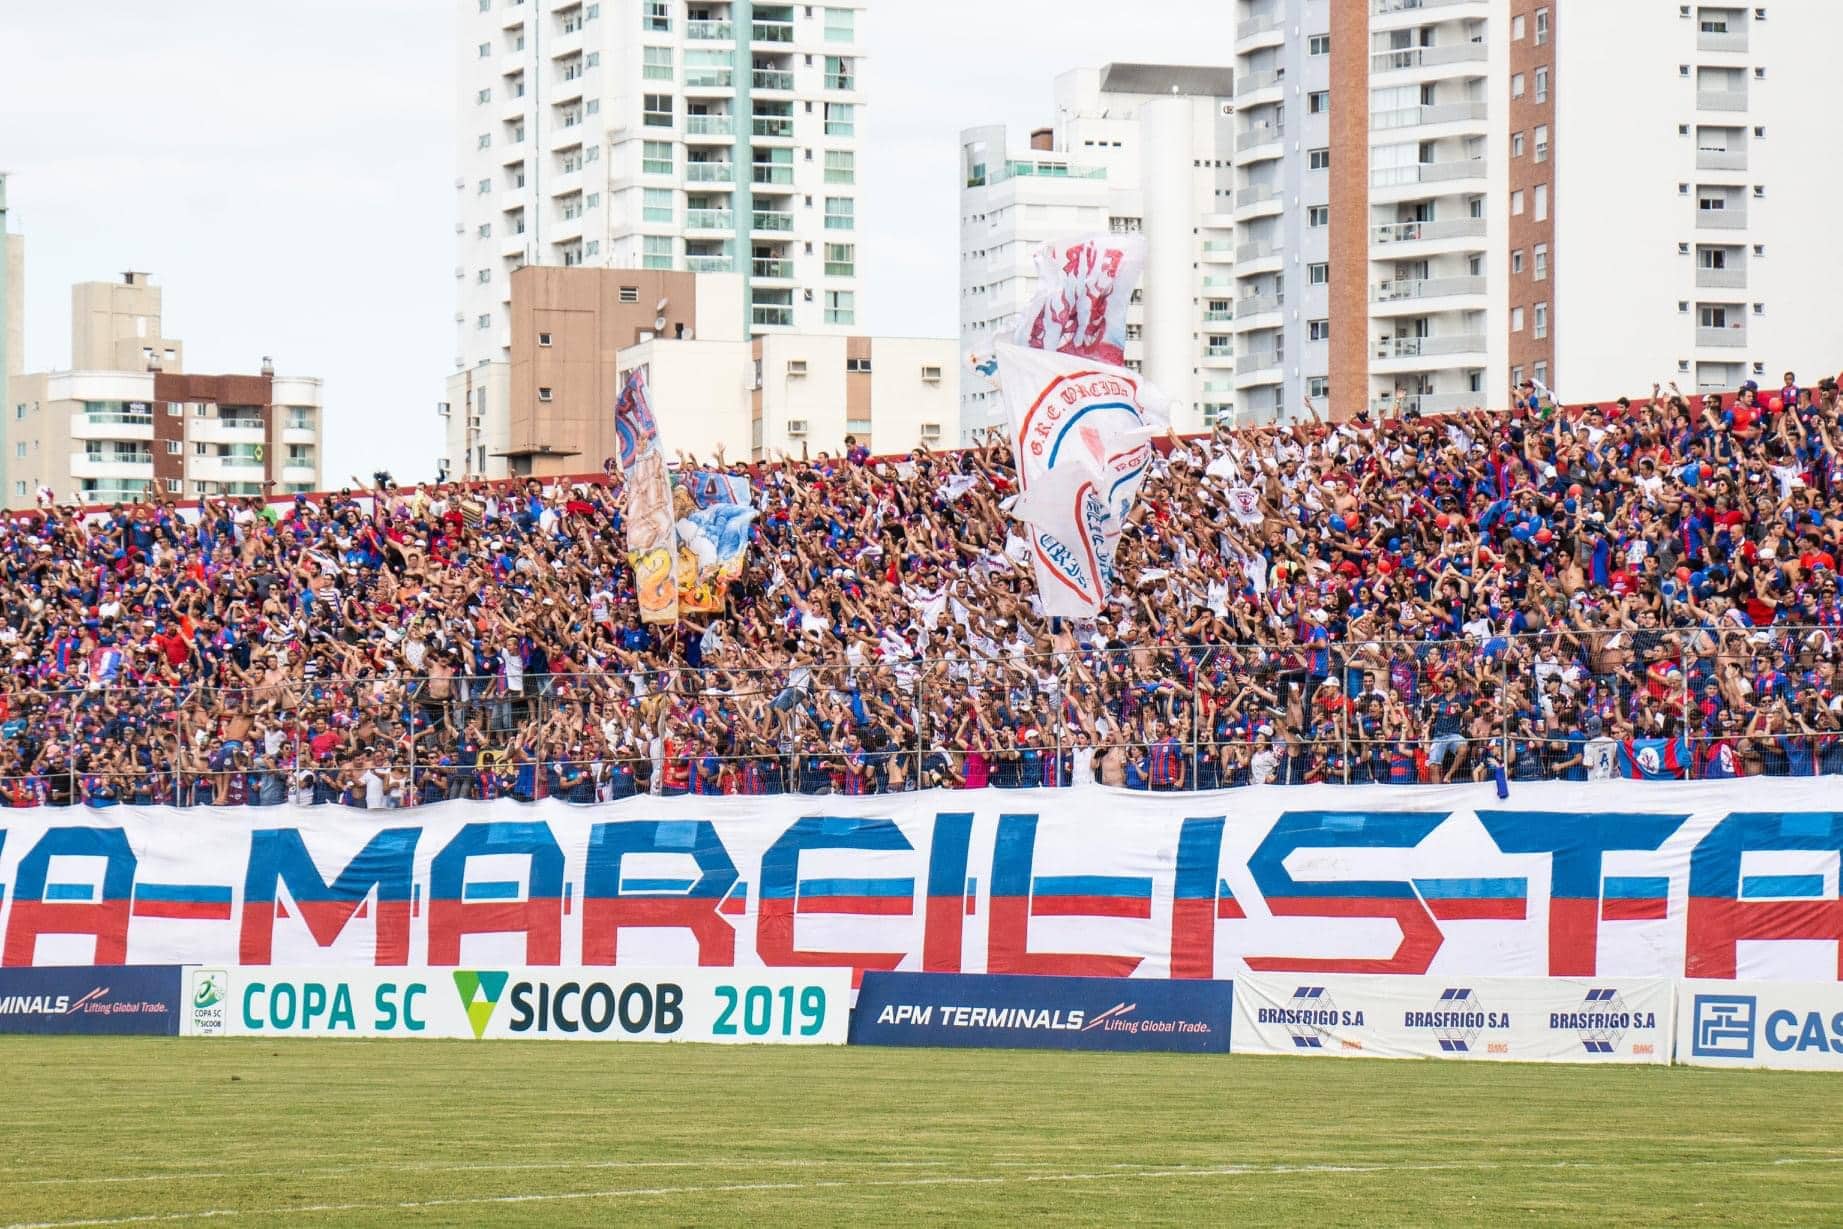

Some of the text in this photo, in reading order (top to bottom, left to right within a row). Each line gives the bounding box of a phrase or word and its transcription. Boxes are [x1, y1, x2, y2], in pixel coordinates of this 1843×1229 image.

[84, 1001, 111, 1015] Lifting
[113, 1002, 139, 1014] Global
[242, 982, 826, 1036] COPA SC SICOOB 2019
[877, 1005, 933, 1025] APM
[940, 1006, 1084, 1030] TERMINALS
[1104, 1019, 1138, 1034] Lifting
[1141, 1020, 1175, 1032] Global
[1258, 1008, 1364, 1026] BRASFRIGO S.A
[1405, 1011, 1510, 1028] BRASFRIGO S.A
[1550, 1012, 1655, 1029] BRASFRIGO S.A
